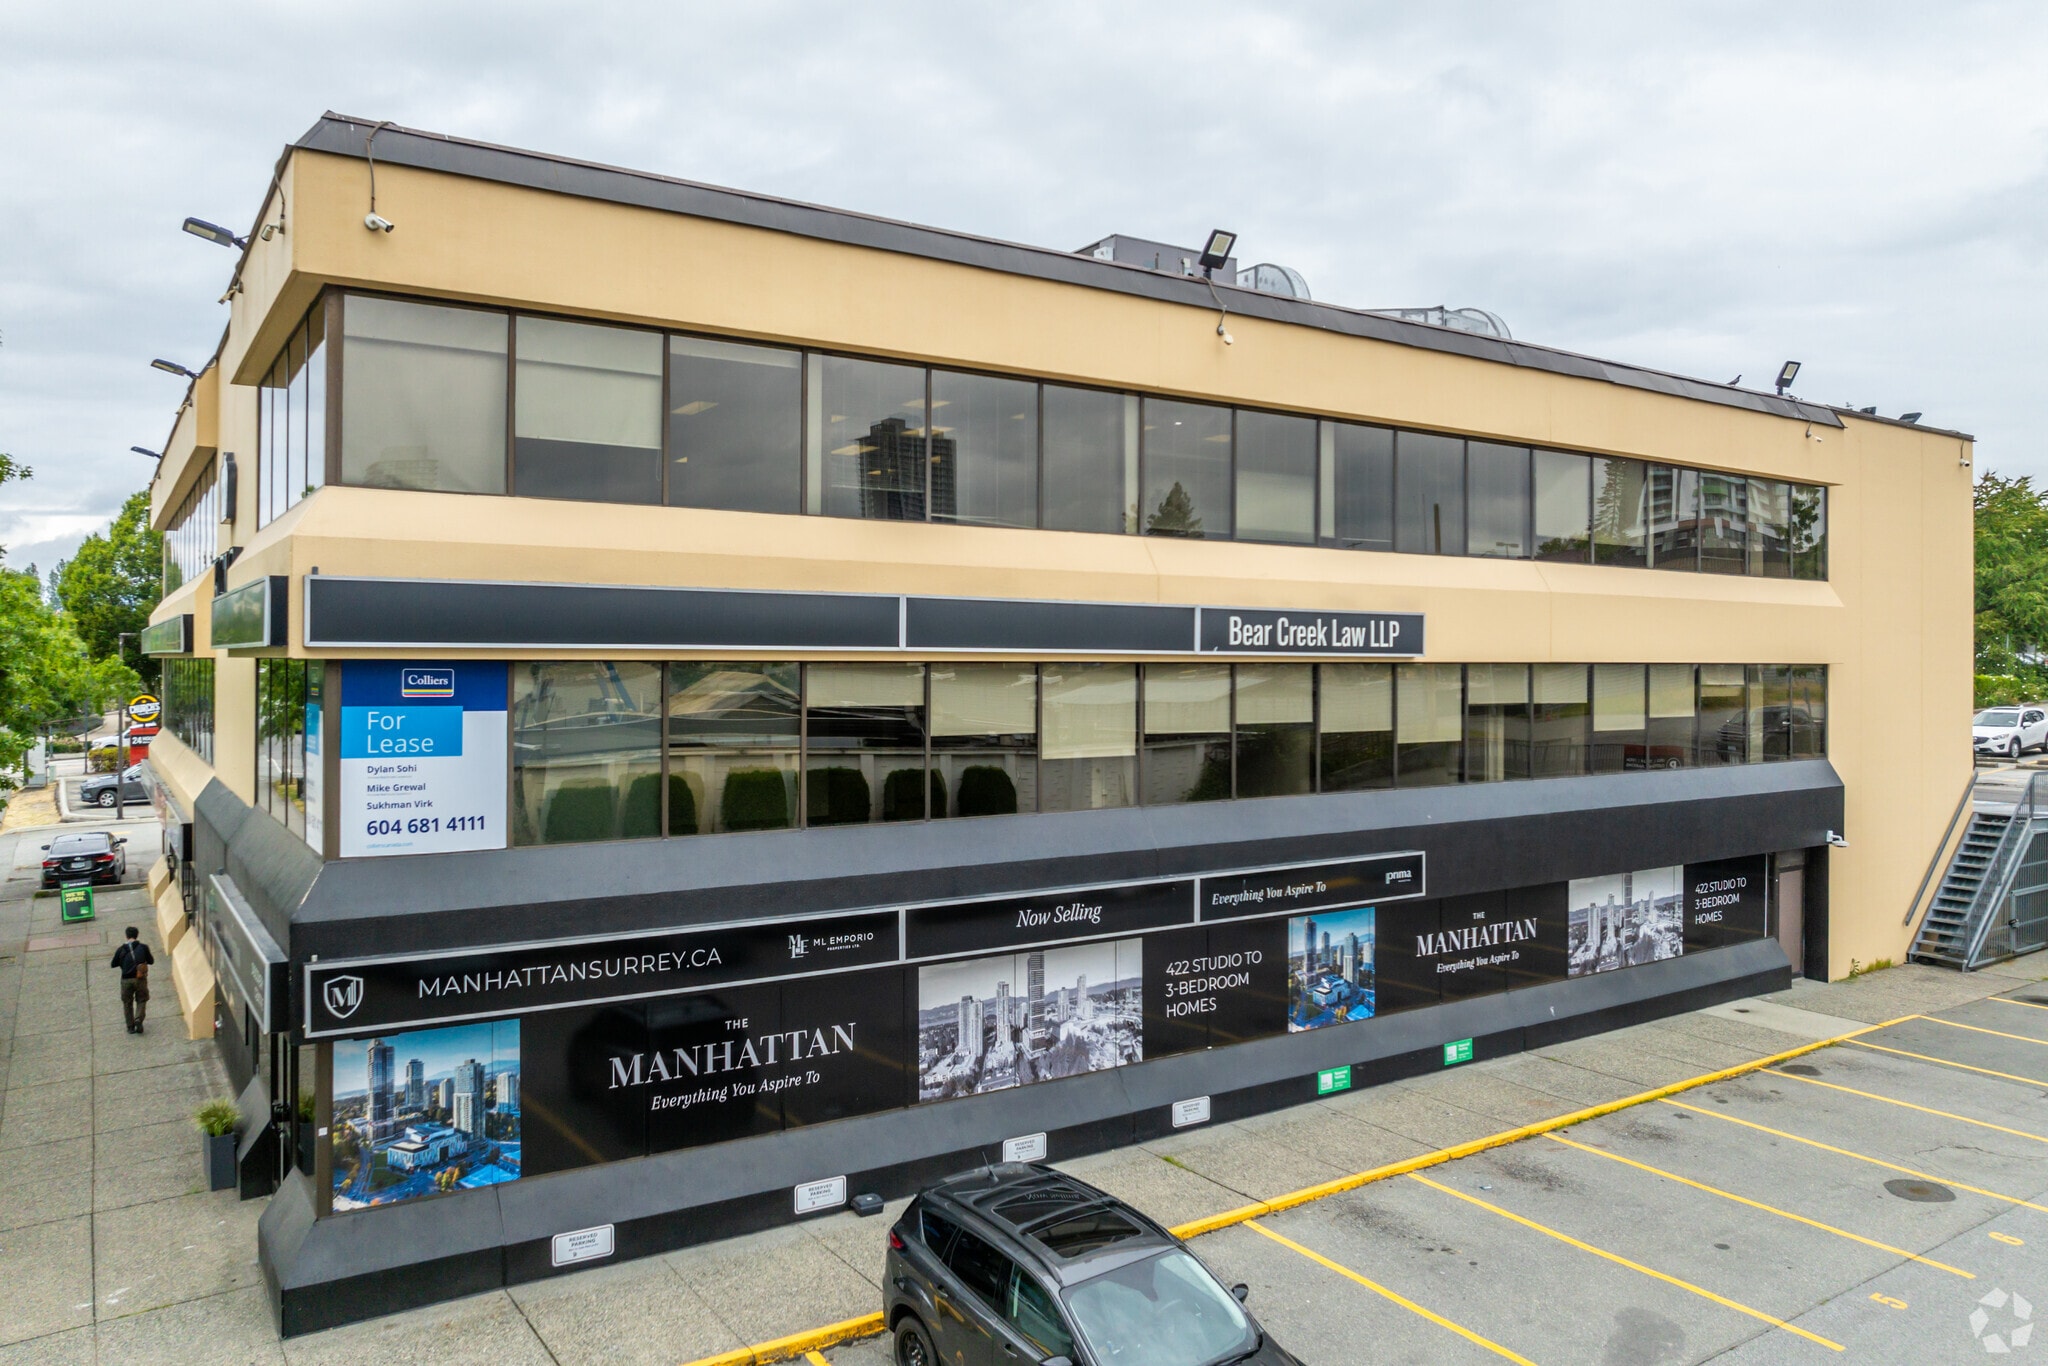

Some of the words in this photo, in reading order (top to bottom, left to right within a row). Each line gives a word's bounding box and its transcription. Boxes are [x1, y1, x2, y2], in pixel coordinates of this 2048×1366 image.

[1228, 615, 1273, 646] Bear
[1276, 616, 1328, 647] Creek
[1331, 618, 1366, 648] Law
[1369, 619, 1400, 648] LLP
[407, 674, 449, 686] Colliers
[367, 711, 406, 731] For
[367, 734, 434, 754] Lease
[367, 765, 395, 775] Dylan
[396, 764, 417, 772] Sohi
[367, 784, 390, 792] Mike
[393, 782, 426, 792] Grewal
[366, 801, 412, 810] Sukhman
[414, 800, 433, 808] Virk
[366, 819, 402, 836] 604
[407, 817, 440, 834] 681
[446, 815, 486, 832] 4111
[1212, 889, 1264, 906] Everything
[1266, 887, 1282, 898] You
[1284, 884, 1314, 898] Aspire
[1316, 881, 1327, 892] To
[1695, 883, 1708, 894] 422
[1709, 878, 1736, 892] STUDIO
[1736, 877, 1747, 888] TO
[1695, 893, 1740, 910] 3-BEDROOM
[1016, 908, 1051, 928] Now
[1053, 903, 1103, 924] Selling
[1472, 911, 1486, 920] THE
[1695, 910, 1723, 925] HOMES
[813, 938, 827, 947] ML
[829, 932, 874, 945] EMPORIO
[1416, 917, 1538, 957] MANHATTAN
[1165, 960, 1190, 976] 422
[1192, 953, 1242, 973] STUDIO
[1243, 950, 1263, 965] TO
[1436, 958, 1475, 973] Everything
[1476, 956, 1488, 966] You
[1489, 952, 1510, 966] Aspire
[1511, 950, 1520, 960] To
[418, 947, 722, 999] MANHATTANSURREY.CA
[1165, 972, 1250, 997] 3-BEDROOM
[1166, 997, 1217, 1018] HOMES
[725, 1018, 749, 1031] THE
[608, 1022, 857, 1089] MANHATTAN
[651, 1086, 728, 1110] Everything
[732, 1082, 756, 1097] You
[758, 1075, 802, 1094] Aspire
[805, 1070, 820, 1084] To
[569, 1233, 598, 1242] RESERVED
[571, 1239, 595, 1247] PARKING
[1869, 1292, 1908, 1310] 5
